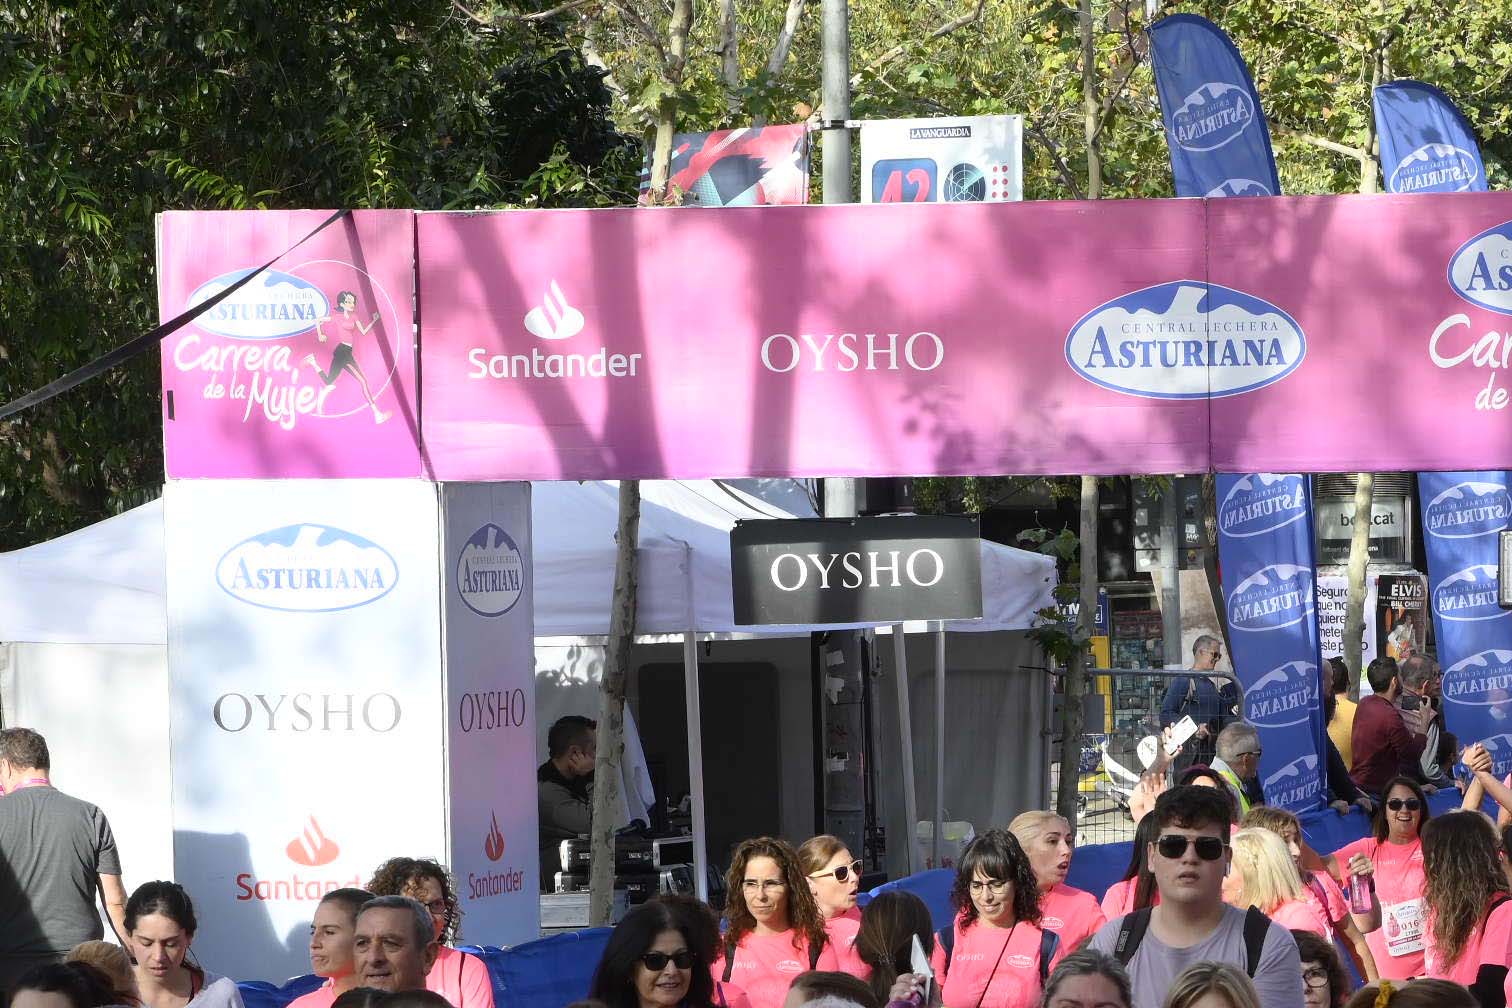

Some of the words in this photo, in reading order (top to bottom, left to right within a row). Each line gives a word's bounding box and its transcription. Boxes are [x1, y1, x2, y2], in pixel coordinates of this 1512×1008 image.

[1121, 322, 1197, 334] CENTRAL
[174, 335, 291, 372] Carrera
[469, 346, 641, 380] Santander
[760, 331, 945, 373] OYSHO
[1084, 326, 1287, 369] ASTURIANA
[203, 379, 225, 399] de
[230, 373, 246, 399] la
[243, 369, 337, 430] Mujer
[1475, 371, 1508, 411] de
[231, 557, 385, 591] ASTURIANA
[462, 559, 520, 595] ASTURIANA
[770, 549, 944, 591] OYSHO
[1391, 584, 1422, 597] ELVIS
[213, 693, 402, 733] OYSHO
[459, 688, 526, 733] OYSHO
[468, 867, 524, 900] Santander
